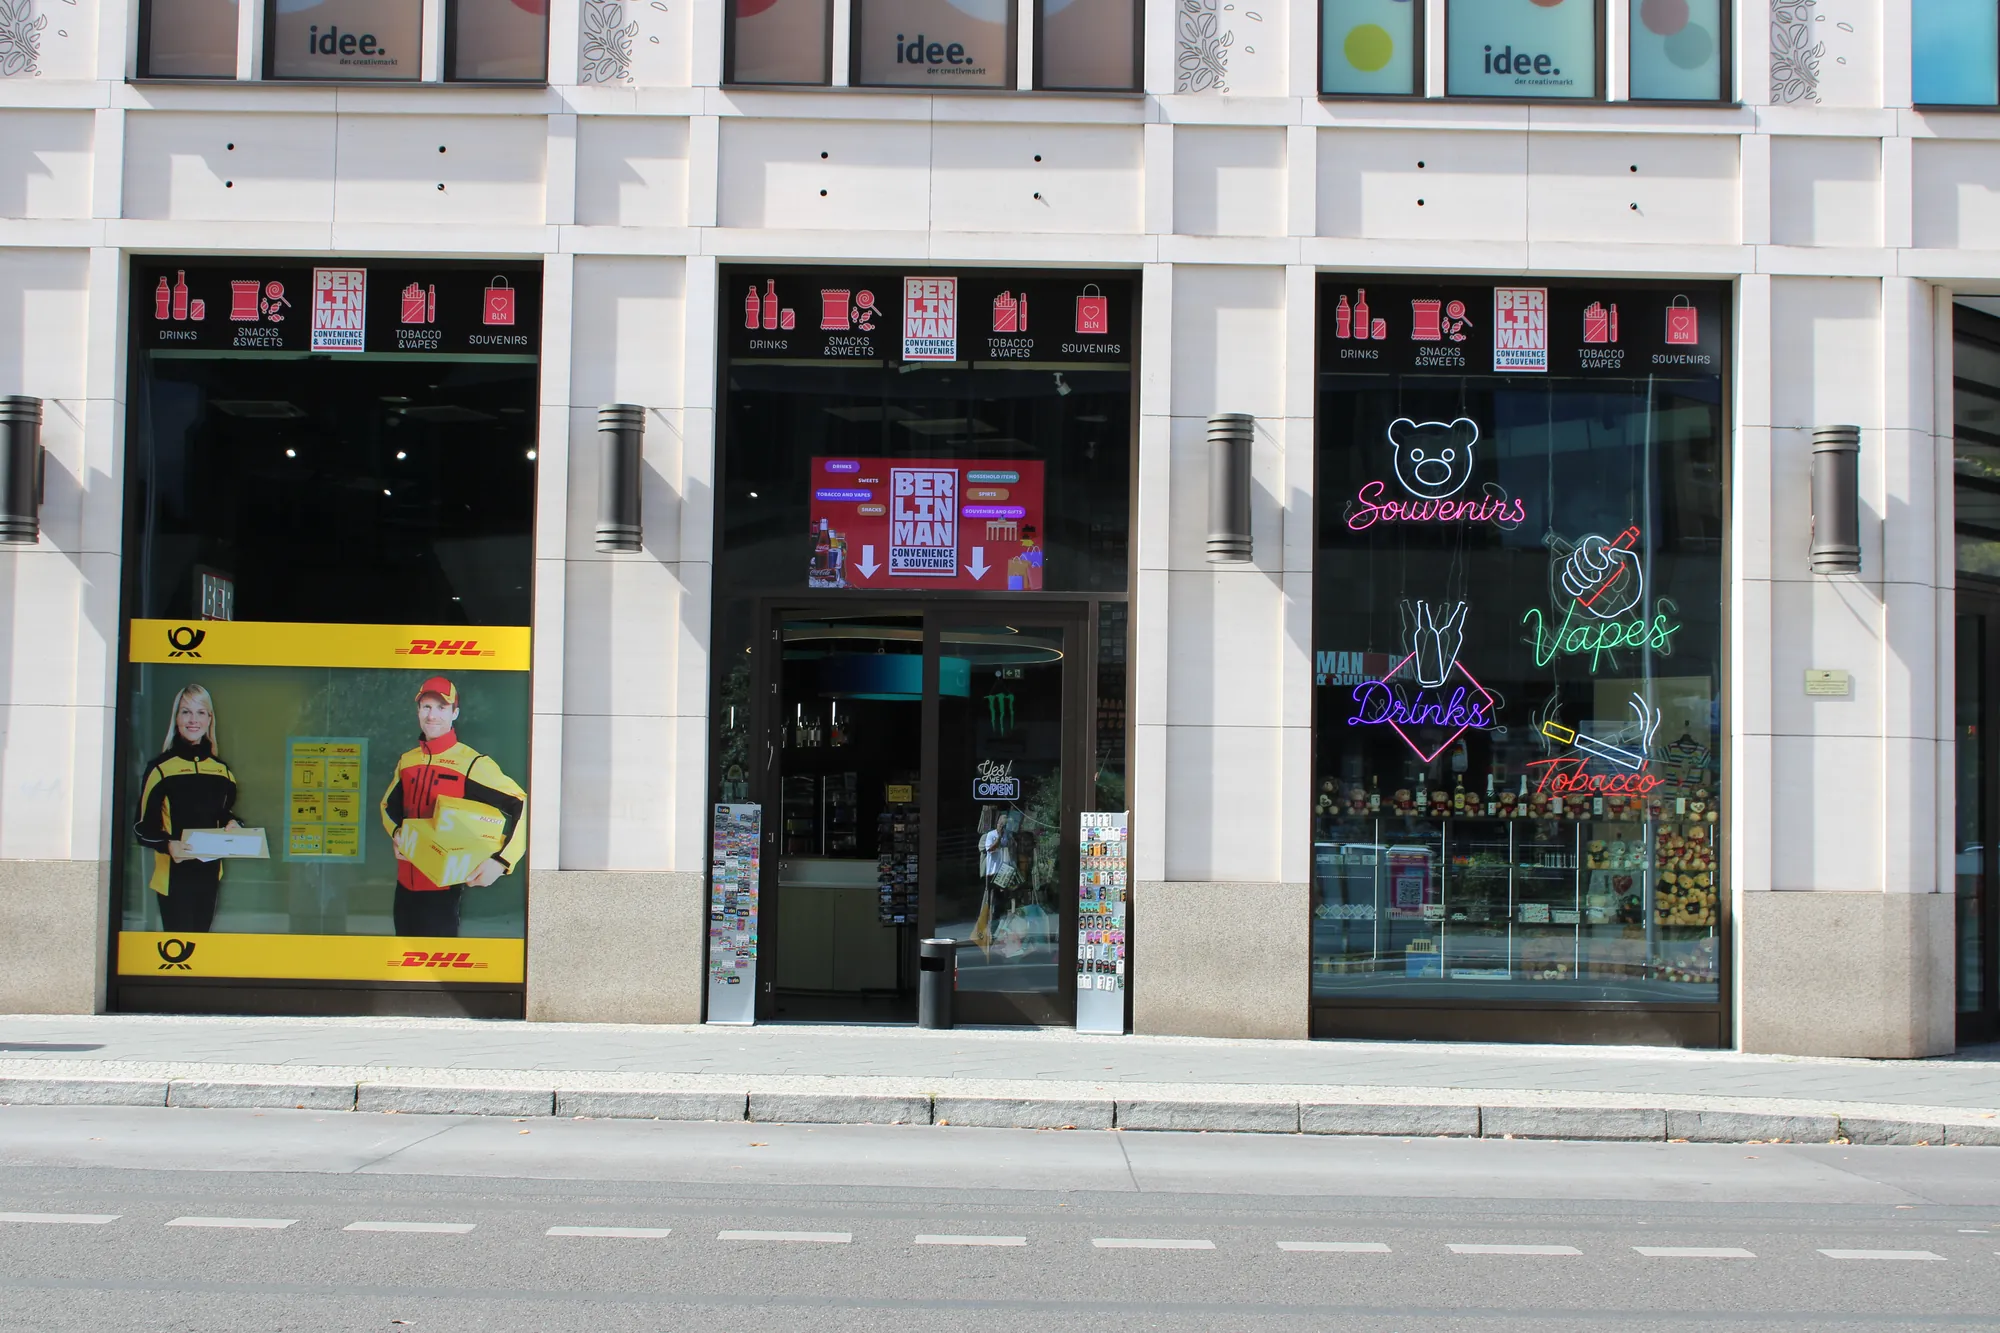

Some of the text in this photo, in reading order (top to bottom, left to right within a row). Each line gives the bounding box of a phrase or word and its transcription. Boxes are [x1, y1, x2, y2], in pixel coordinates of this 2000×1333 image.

[310, 25, 386, 56] idee.
[897, 34, 973, 65] idee.
[352, 58, 398, 66] creativmarkt
[1484, 45, 1560, 75] idee.
[927, 67, 986, 75] der creativmarkt
[1514, 78, 1573, 86] der creativmarkt
[316, 271, 363, 291] BER
[907, 280, 954, 299] BER
[316, 290, 363, 310] LIN
[1497, 290, 1543, 310] BER
[907, 299, 954, 319] LIN
[315, 309, 362, 329] MAN
[491, 312, 507, 320] BLN
[1497, 309, 1544, 329] LIN
[907, 318, 953, 338] MAN
[1084, 321, 1099, 329] BLN
[159, 330, 197, 340] DRINKS
[238, 327, 278, 337] SNACKS
[313, 330, 363, 338] CONVENIENCE
[395, 329, 442, 339] TOBACCO
[1673, 332, 1688, 340] BLN
[233, 337, 283, 347] &SWEETS
[313, 338, 363, 346] & SOUVENIRS
[469, 334, 528, 345] SOUVENIRS
[828, 336, 870, 346] SNACKS
[905, 339, 954, 347] CONVENIENCE
[987, 338, 1034, 348] TOBACCO
[1497, 329, 1544, 348] MAN
[398, 340, 438, 349] &VAPES
[750, 340, 788, 349] DRINKS
[1061, 343, 1121, 353] SOUVENIRS
[823, 346, 874, 356] &SWEETS
[914, 347, 954, 355] SOUVENIRS
[990, 348, 1030, 358] &VAPES
[1340, 349, 1379, 359] DRINKS
[1419, 346, 1461, 356] SNACKS
[1496, 350, 1546, 358] CONVENIENCE
[1577, 349, 1625, 359] TOBACCO
[1415, 356, 1465, 366] &SWEETS
[1505, 358, 1546, 366] SOUVENIRS
[1581, 359, 1621, 369] &VAPES
[1651, 354, 1711, 364] SOUVENIRS
[894, 472, 954, 496] BER
[894, 497, 953, 521] LIN
[1348, 481, 1526, 530] Souvenirs
[894, 521, 953, 546] MAN
[891, 548, 954, 558] CONVENIENCE
[891, 558, 954, 568] & SOUVENIRS
[1523, 599, 1680, 672] Vapes
[408, 639, 482, 656] DHL
[1316, 651, 1364, 675] MAN
[1348, 680, 1490, 728] Drinks
[977, 759, 1013, 781] Yes!
[1526, 757, 1665, 794] Tobacco
[978, 783, 1014, 796] OPEN
[439, 809, 456, 832] S
[441, 853, 473, 885] M
[400, 951, 476, 969] DHL
